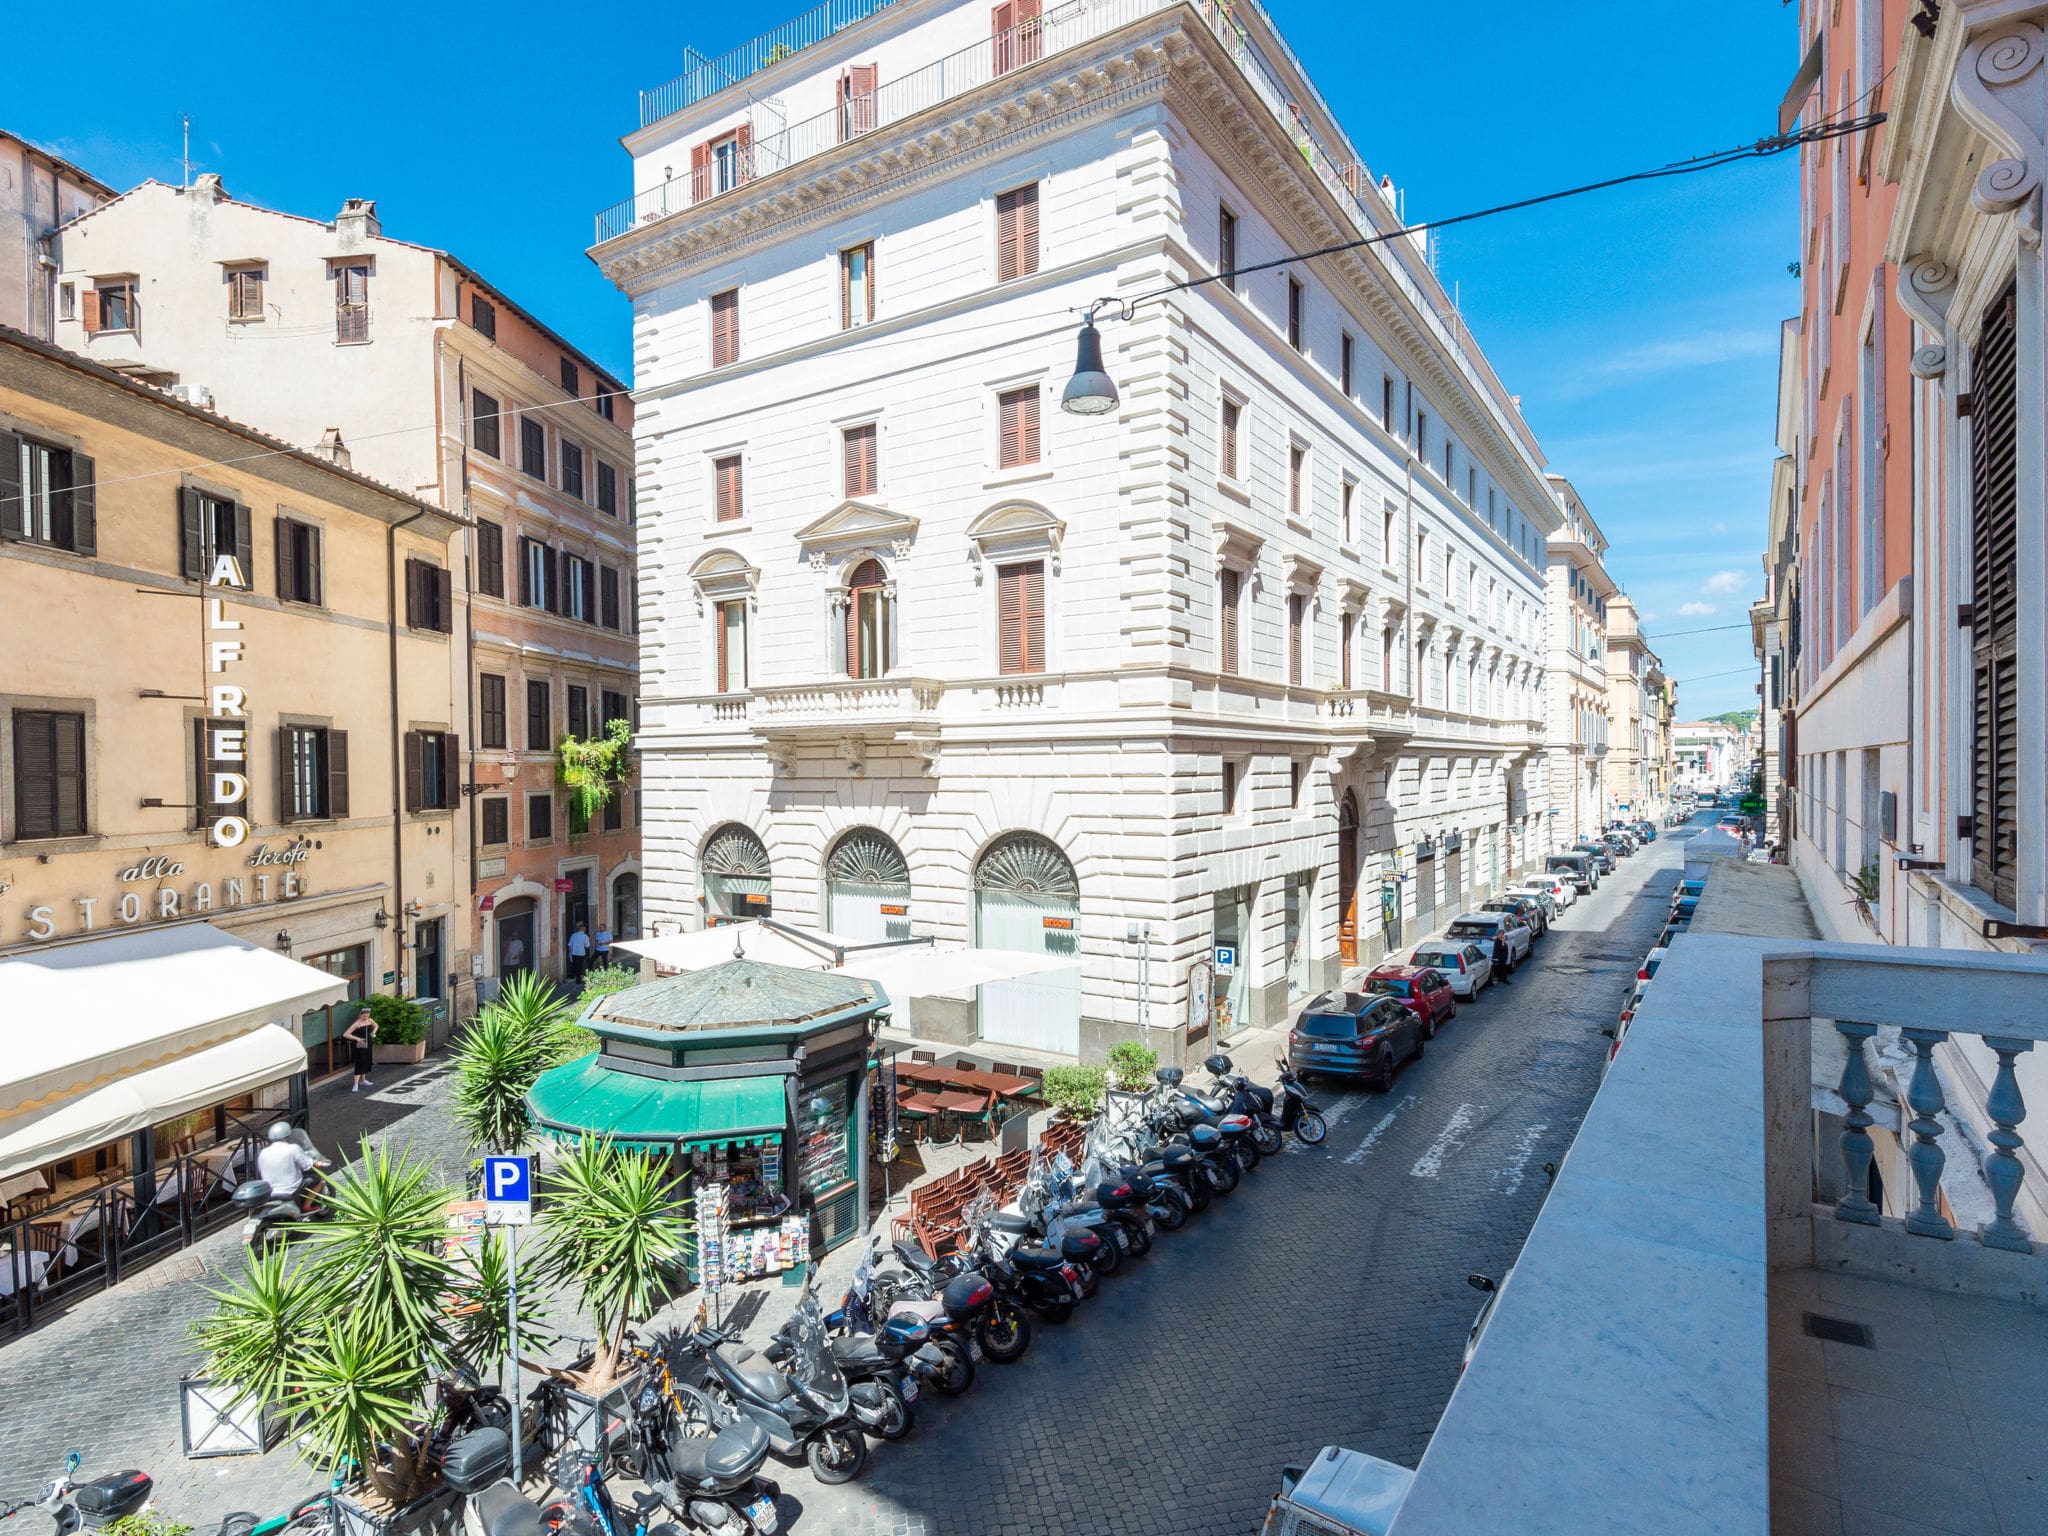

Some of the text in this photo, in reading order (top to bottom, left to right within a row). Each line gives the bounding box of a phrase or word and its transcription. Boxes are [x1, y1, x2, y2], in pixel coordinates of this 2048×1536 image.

[210, 554, 247, 847] ALFREDO
[122, 842, 308, 882] alla Scrofa
[29, 871, 298, 939] STORANTE
[1220, 951, 1229, 962] P
[494, 1162, 520, 1197] P
